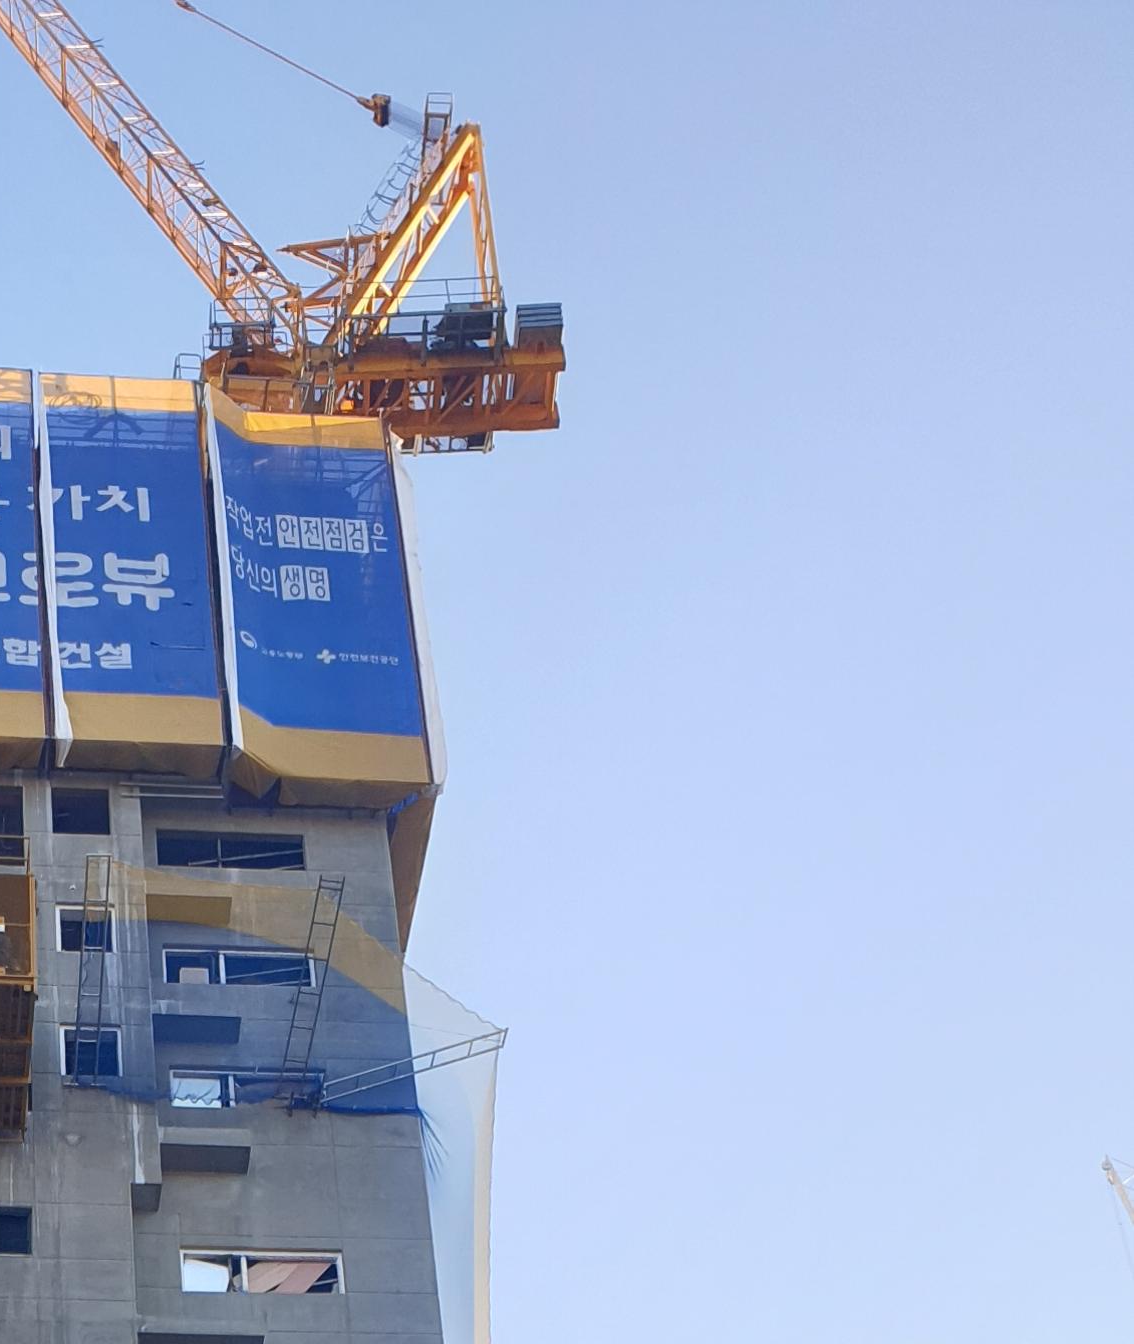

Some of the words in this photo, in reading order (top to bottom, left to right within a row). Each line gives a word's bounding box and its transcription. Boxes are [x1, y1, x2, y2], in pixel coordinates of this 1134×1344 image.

[27, 485, 152, 523] 가치
[231, 544, 278, 598] 당신의
[281, 567, 329, 600] 생명
